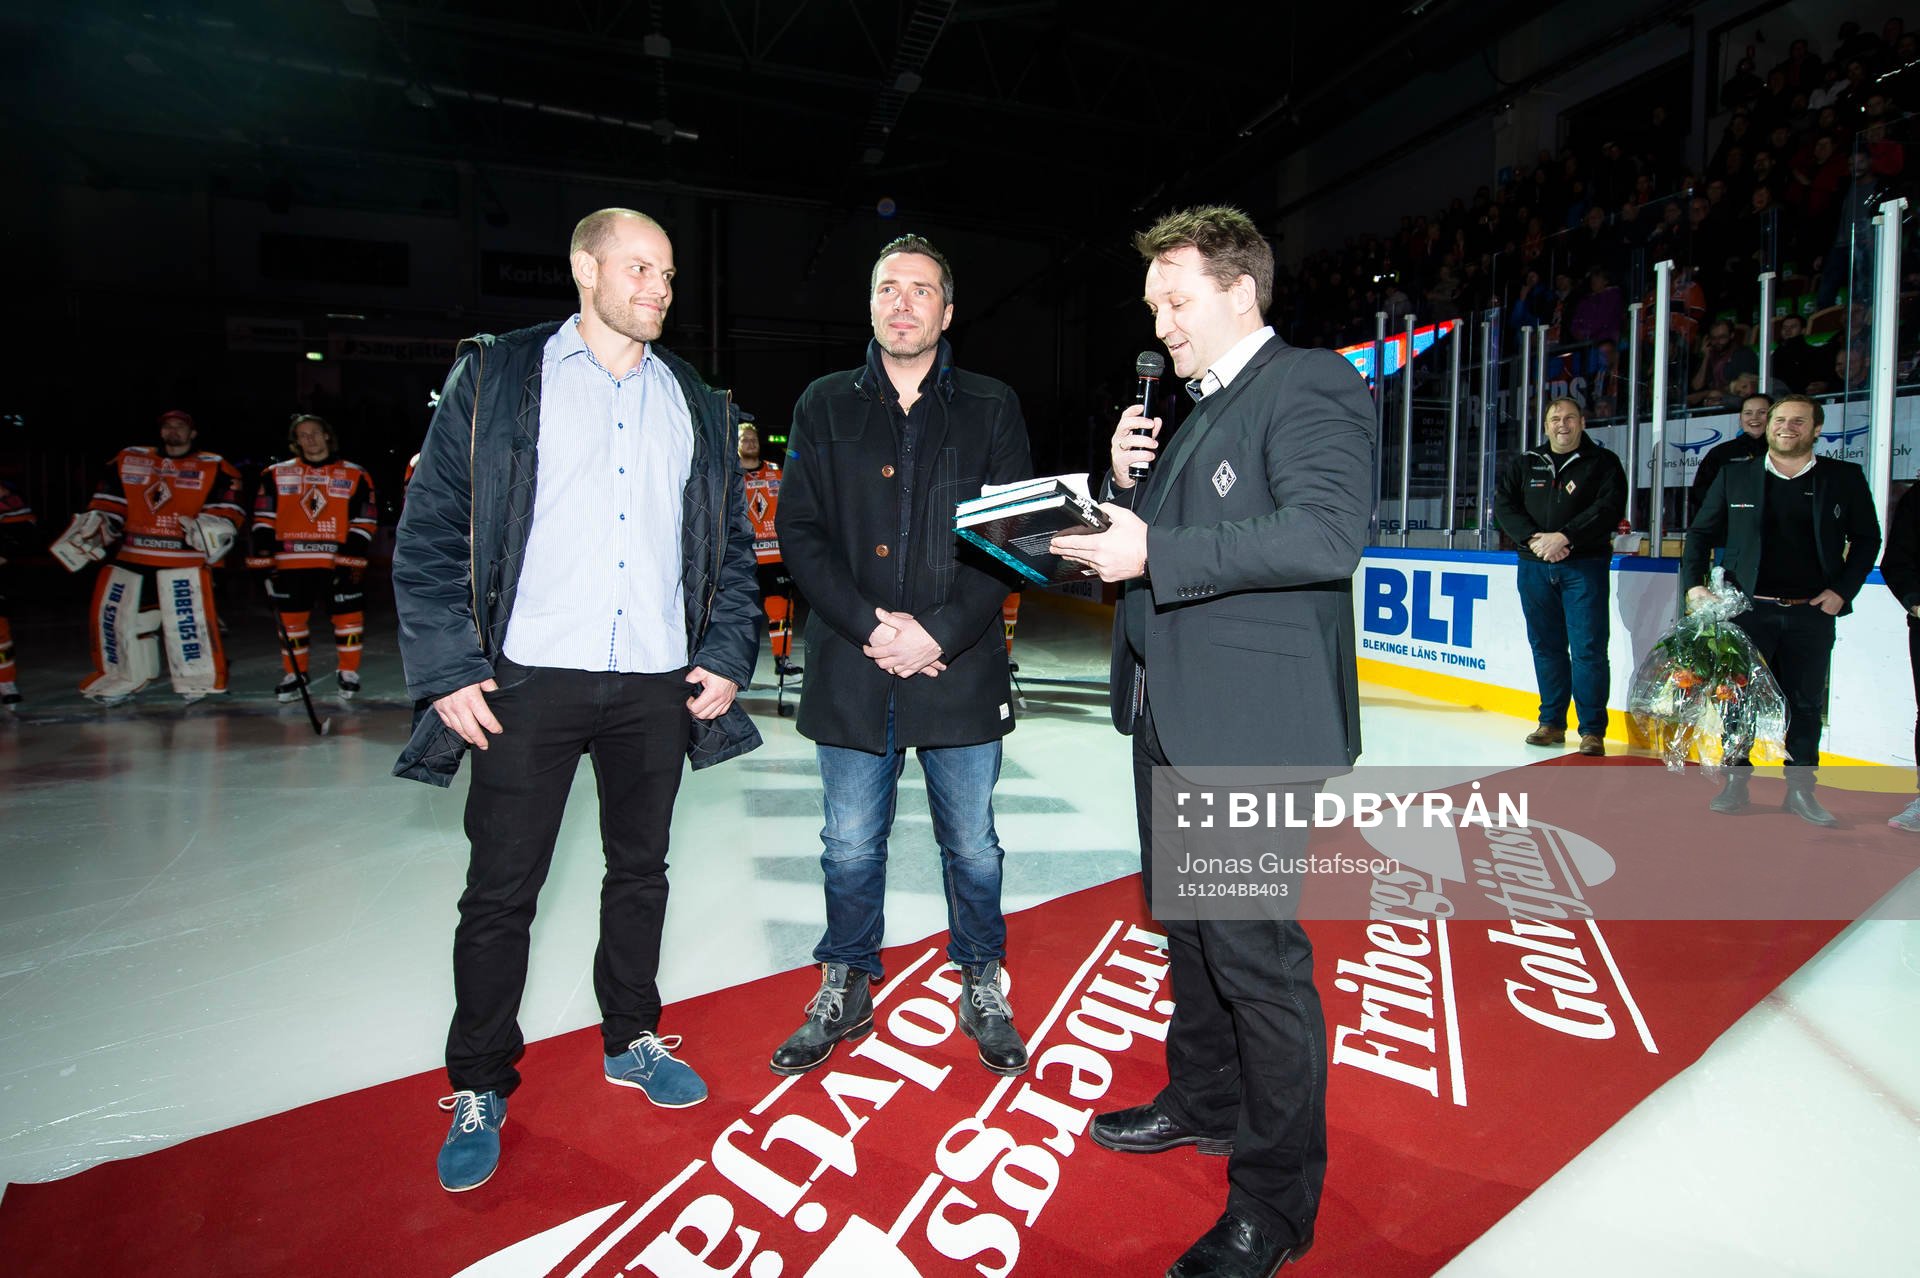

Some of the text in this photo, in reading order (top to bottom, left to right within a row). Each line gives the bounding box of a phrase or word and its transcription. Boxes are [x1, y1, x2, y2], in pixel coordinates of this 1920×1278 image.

[1892, 443, 1912, 456] olv
[1363, 566, 1488, 649] BLT
[182, 643, 202, 662] BIL
[1362, 638, 1486, 670] BLEKINGE LÄNS TIDNING
[1333, 865, 1455, 1098] Fribergs
